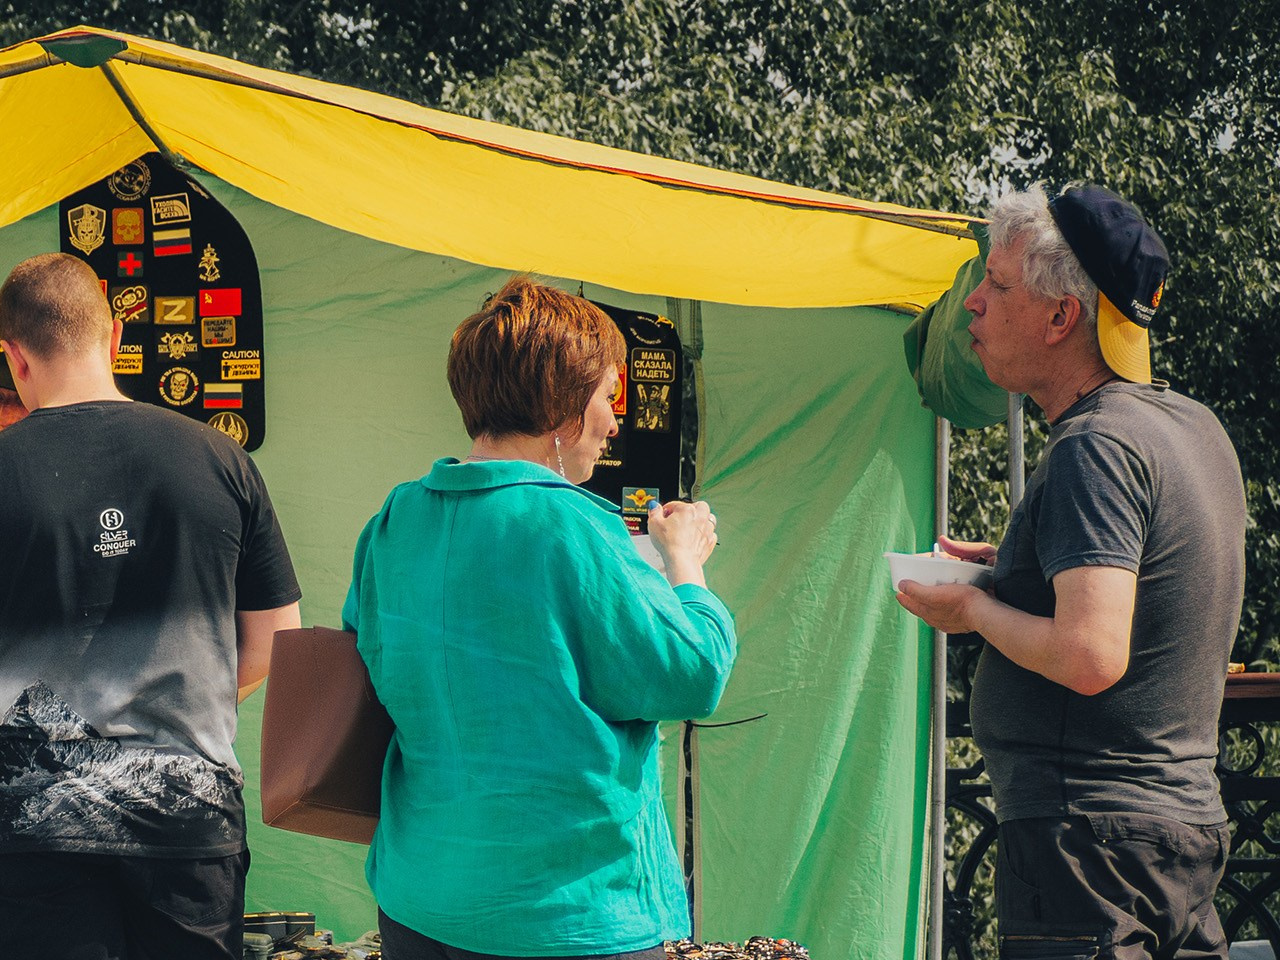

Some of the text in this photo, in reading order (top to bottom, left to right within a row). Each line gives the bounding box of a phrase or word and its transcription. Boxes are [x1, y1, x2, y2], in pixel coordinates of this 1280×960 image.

[162, 300, 186, 321] Z
[118, 344, 143, 353] UTION
[222, 350, 260, 359] CAUTION
[641, 351, 666, 360] МАМА
[634, 360, 672, 370] СКАЗАЛА
[636, 369, 670, 379] НАДЕТЬ
[93, 539, 136, 552] CONQUER
